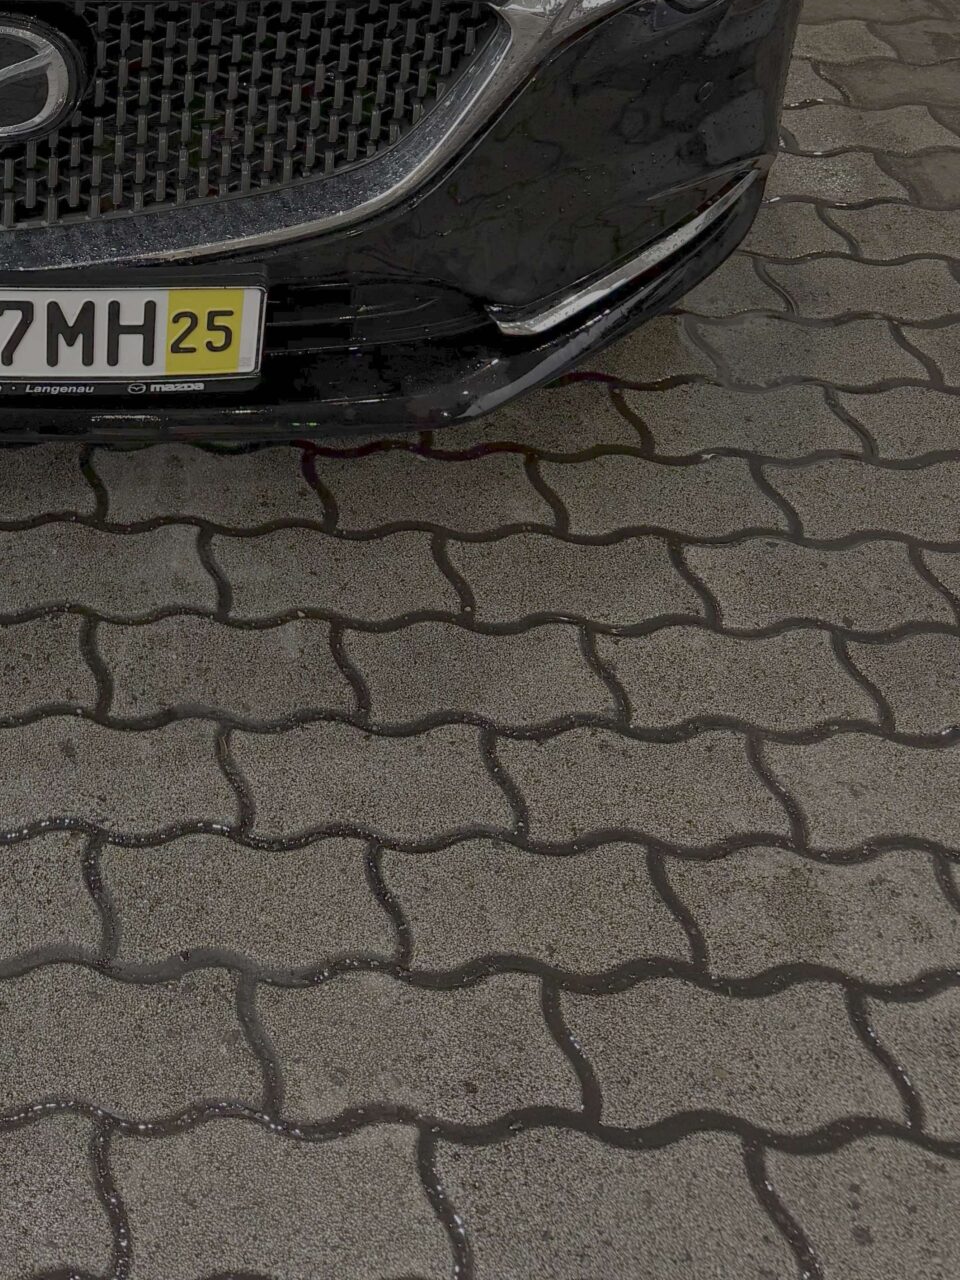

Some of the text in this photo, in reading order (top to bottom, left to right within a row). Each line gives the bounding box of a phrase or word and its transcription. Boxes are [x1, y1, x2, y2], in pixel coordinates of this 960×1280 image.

[170, 310, 234, 354] 25
[25, 383, 95, 395] Langenau
[150, 382, 205, 392] mazda
